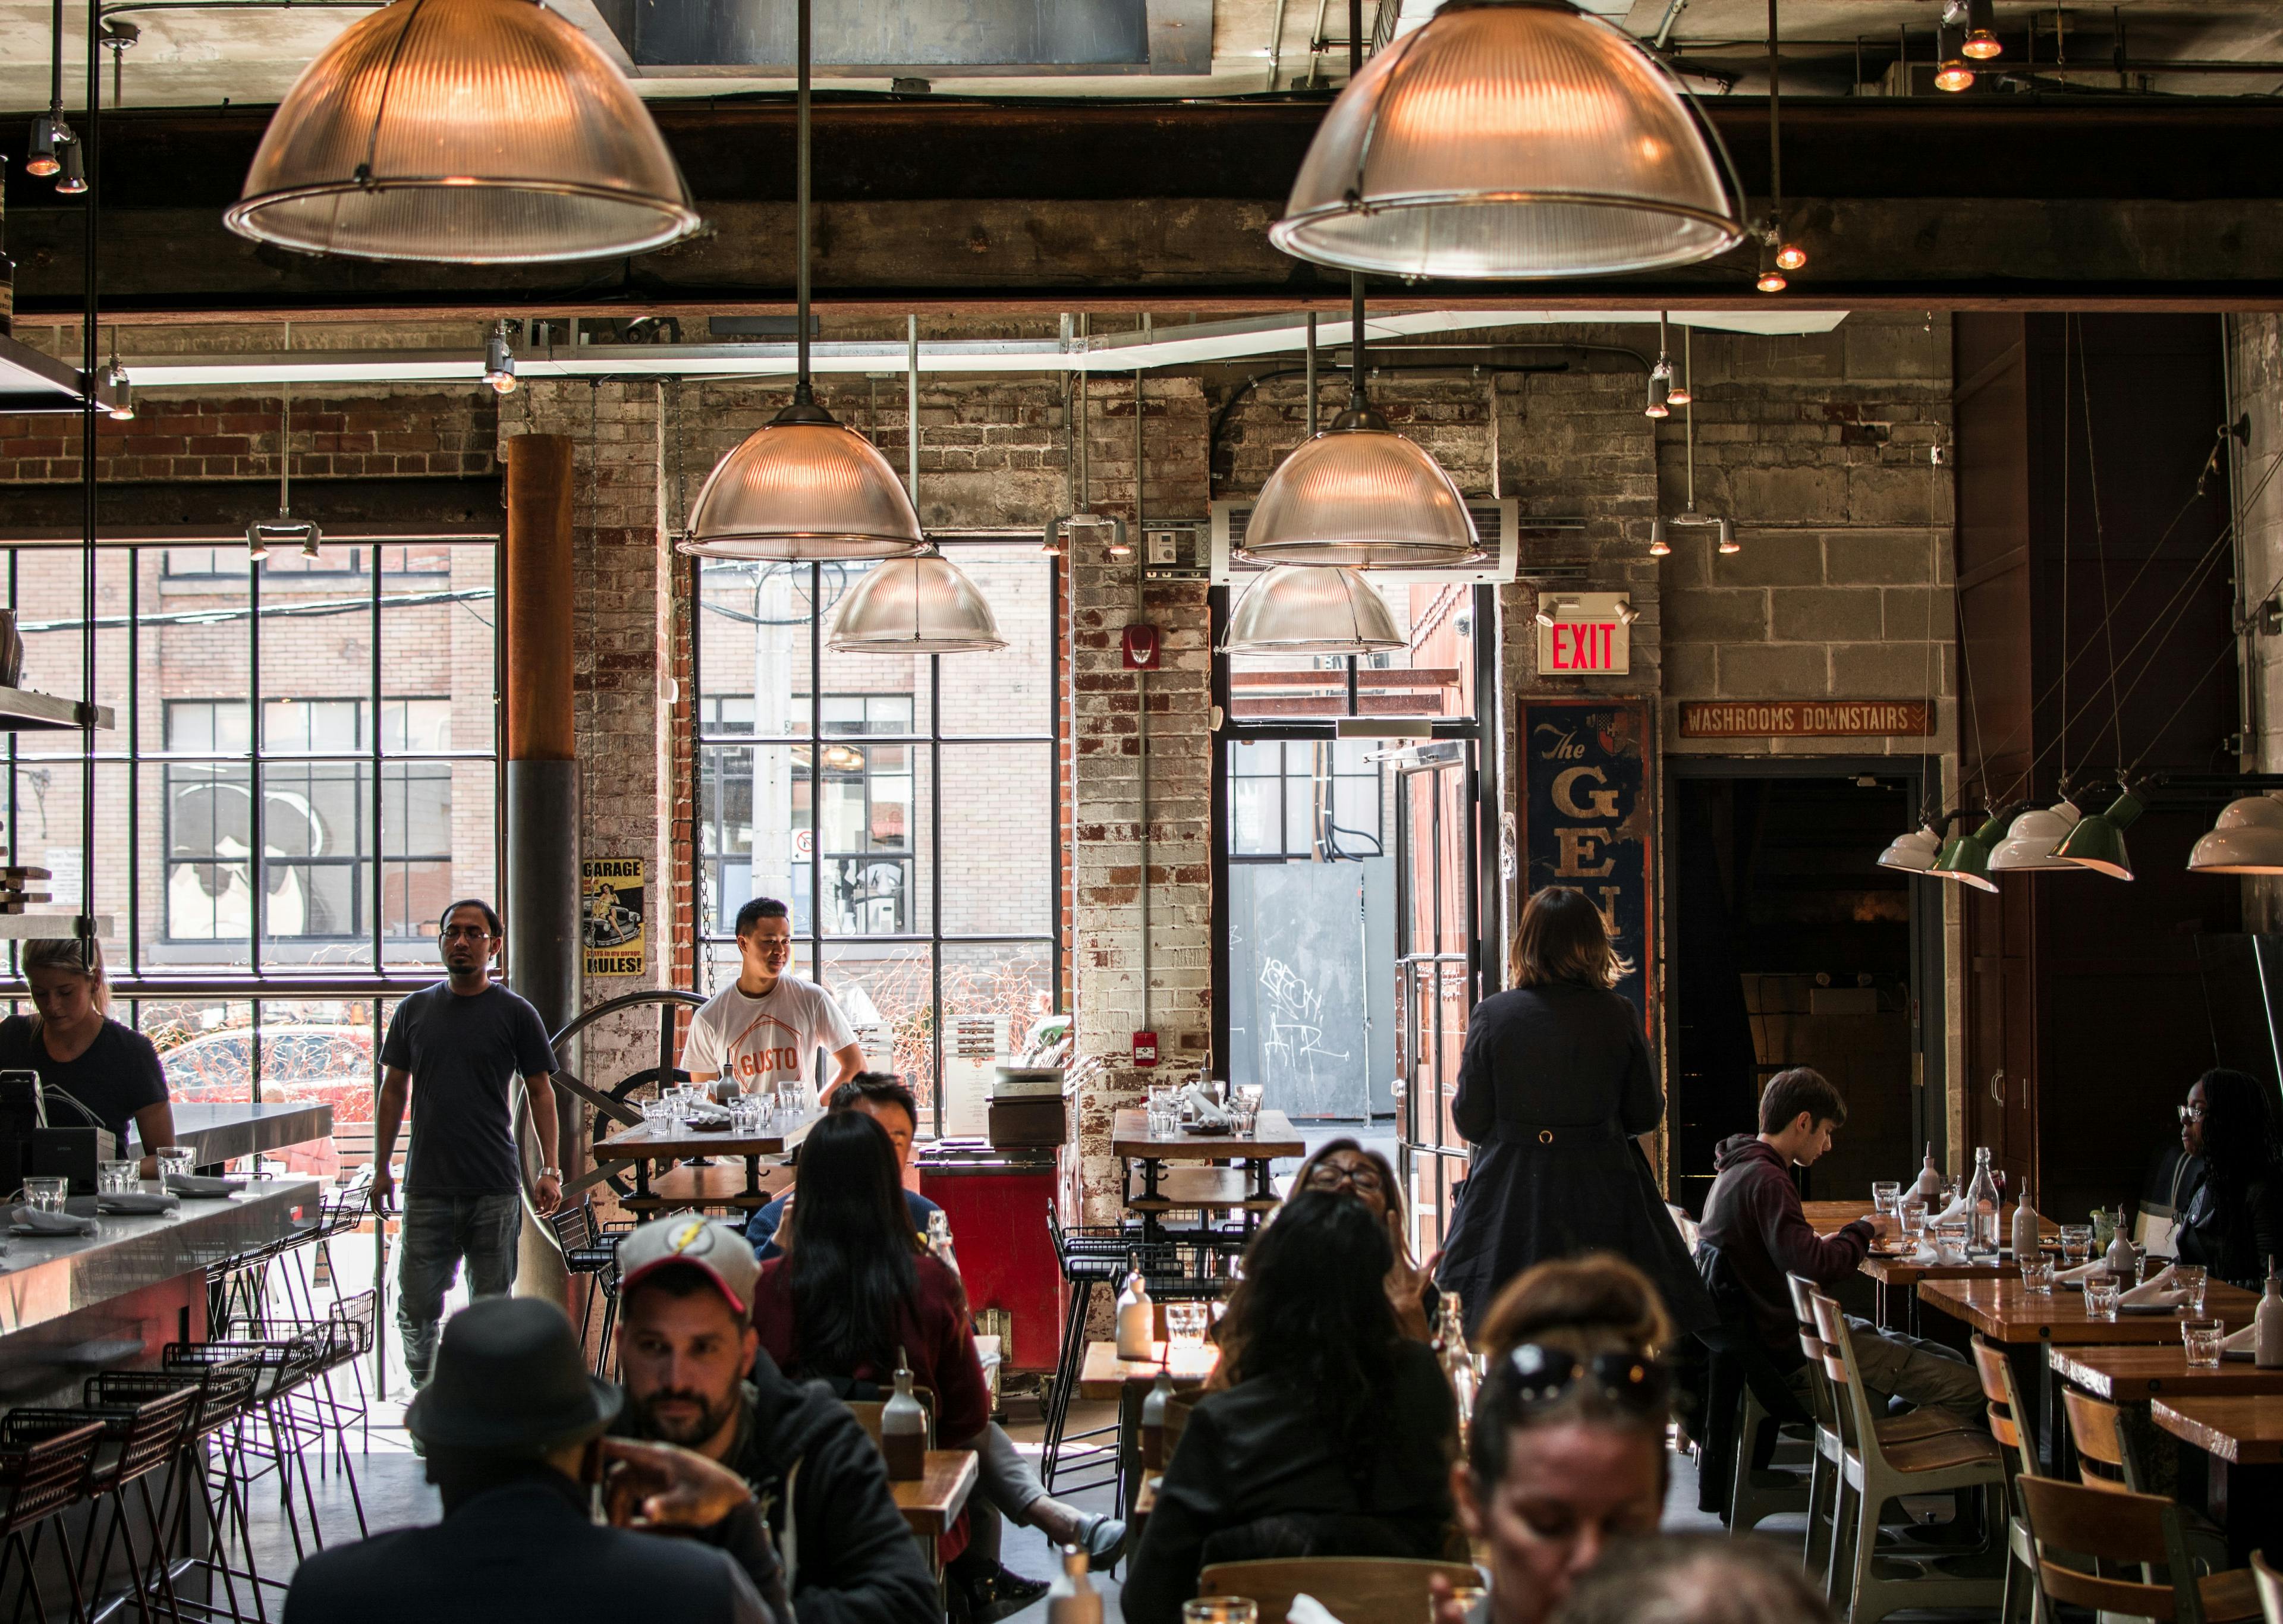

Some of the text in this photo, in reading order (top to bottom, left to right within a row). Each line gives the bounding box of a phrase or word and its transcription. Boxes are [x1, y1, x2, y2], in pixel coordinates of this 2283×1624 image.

[1553, 624, 1615, 669] EXIT
[1688, 707, 1908, 732] WASHROOMS DOWNSTAIRS
[1534, 723, 1586, 760] The
[584, 862, 640, 877] GARAGE
[740, 1047, 797, 1076] GUSTO
